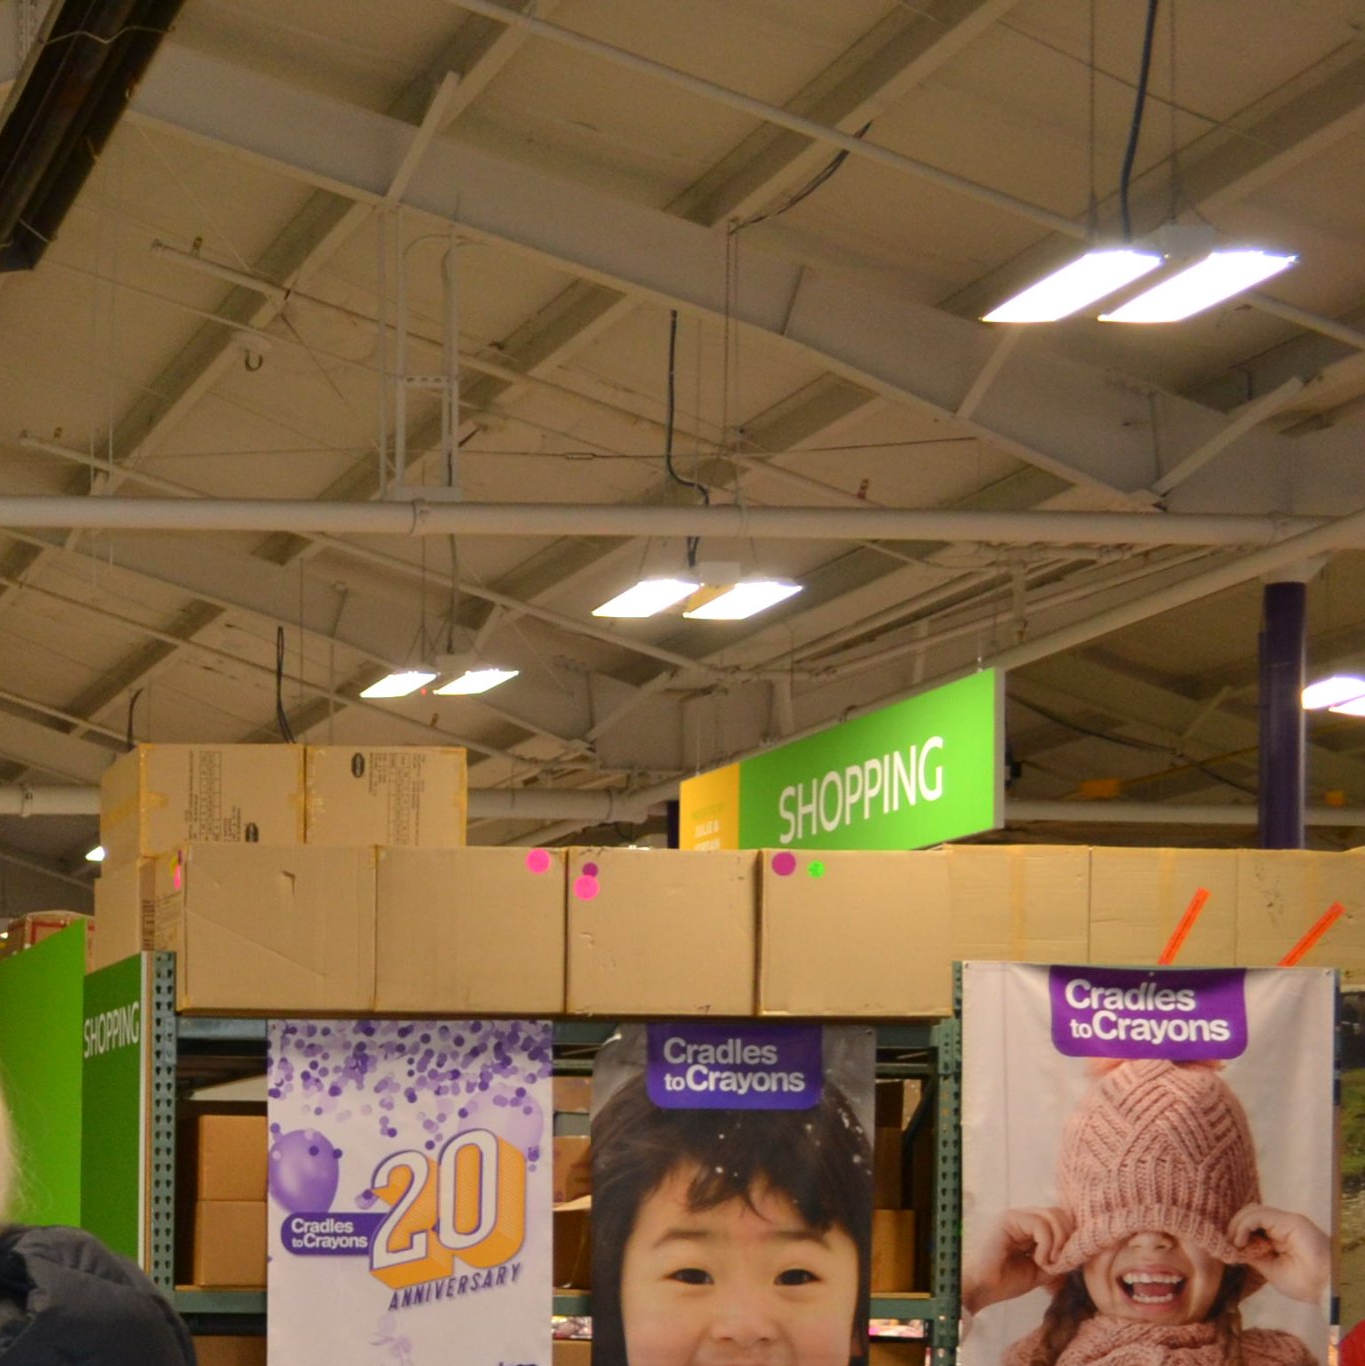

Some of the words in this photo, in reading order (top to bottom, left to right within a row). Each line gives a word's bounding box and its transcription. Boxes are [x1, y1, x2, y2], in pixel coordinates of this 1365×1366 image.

[778, 735, 944, 844] SHOPPING
[1065, 978, 1196, 1012] Cradles
[83, 1000, 140, 1059] SHOPPING
[663, 1036, 779, 1065] Cradles
[291, 1218, 354, 1234] Cradles
[370, 1128, 509, 1275] 20
[388, 1261, 522, 1311] ANNIVERSARY
